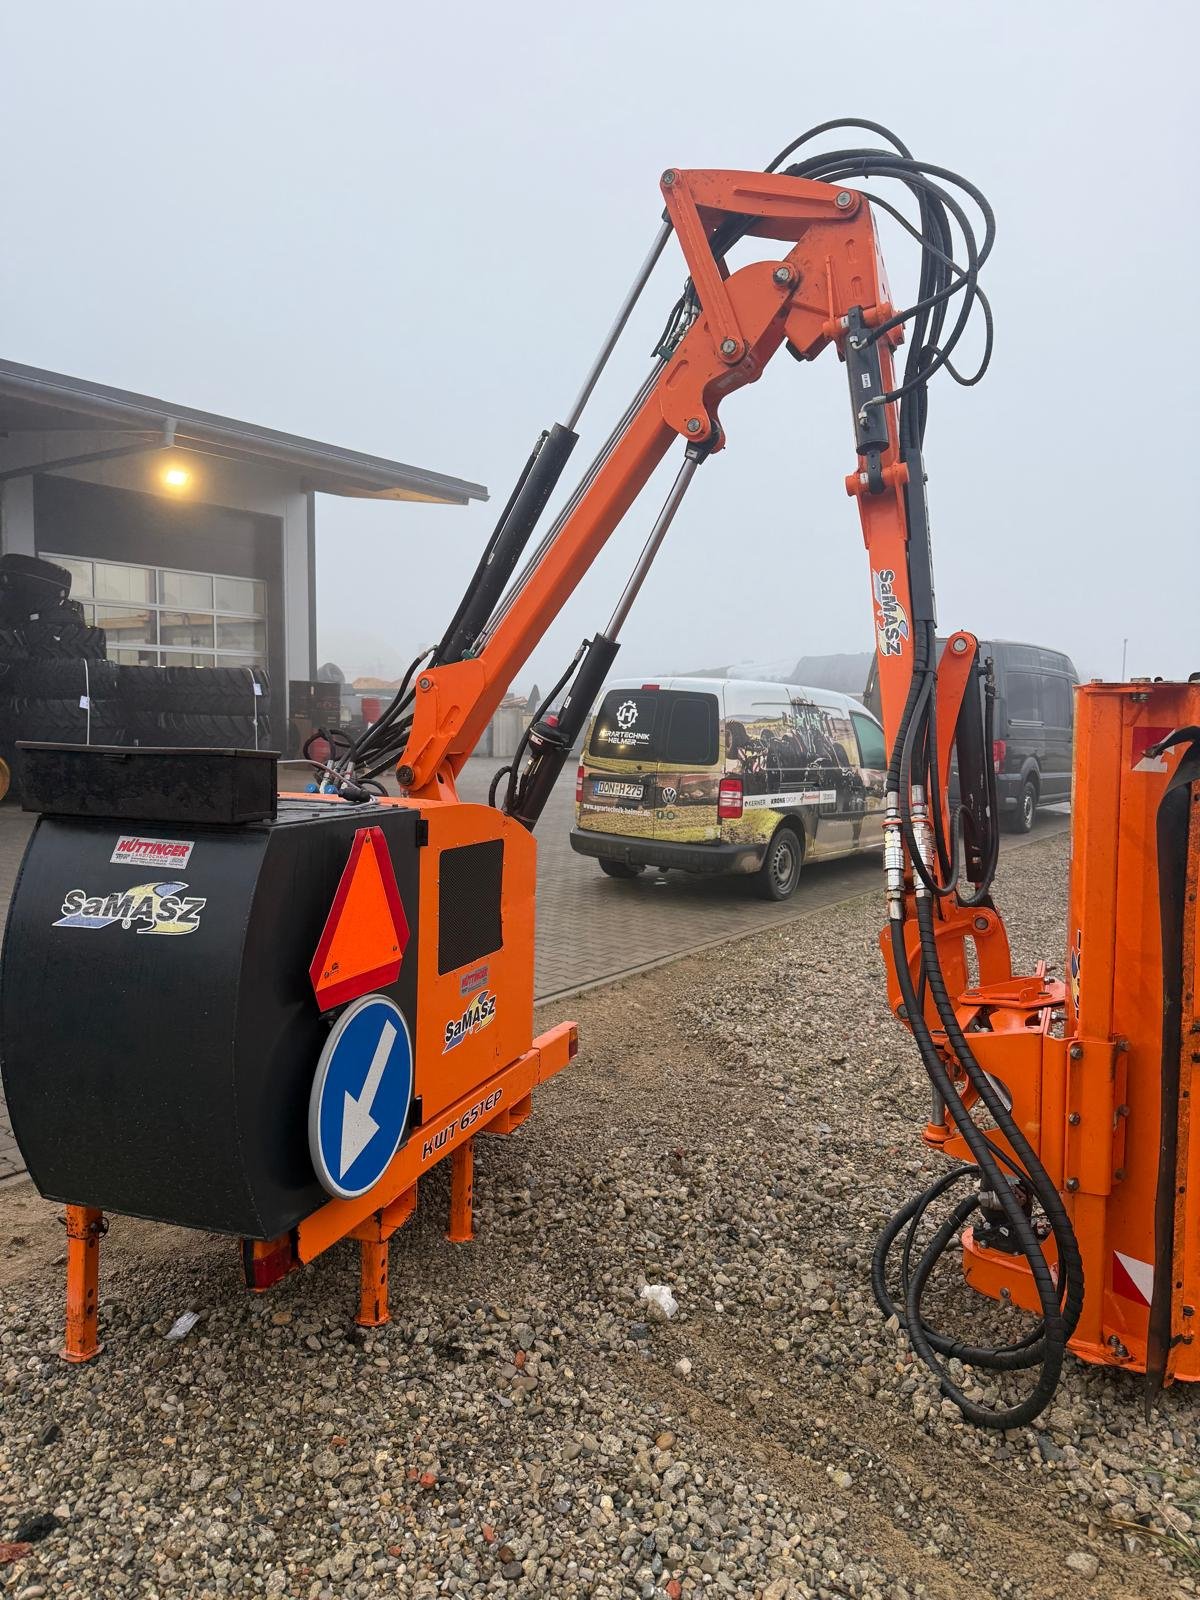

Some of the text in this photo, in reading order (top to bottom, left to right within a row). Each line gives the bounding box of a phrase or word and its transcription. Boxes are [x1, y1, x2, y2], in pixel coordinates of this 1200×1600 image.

[880, 569, 902, 655] SaMASZ
[598, 730, 650, 740] AGRARTECHNIK
[608, 737, 637, 746] HELMER
[600, 782, 642, 797] DON H 275
[748, 799, 766, 807] KERNER
[117, 838, 190, 857] HÜTTINGER
[62, 889, 206, 924] SaMASZ
[445, 995, 497, 1042] SaMASZ
[422, 1088, 503, 1161] KWT 651EP
